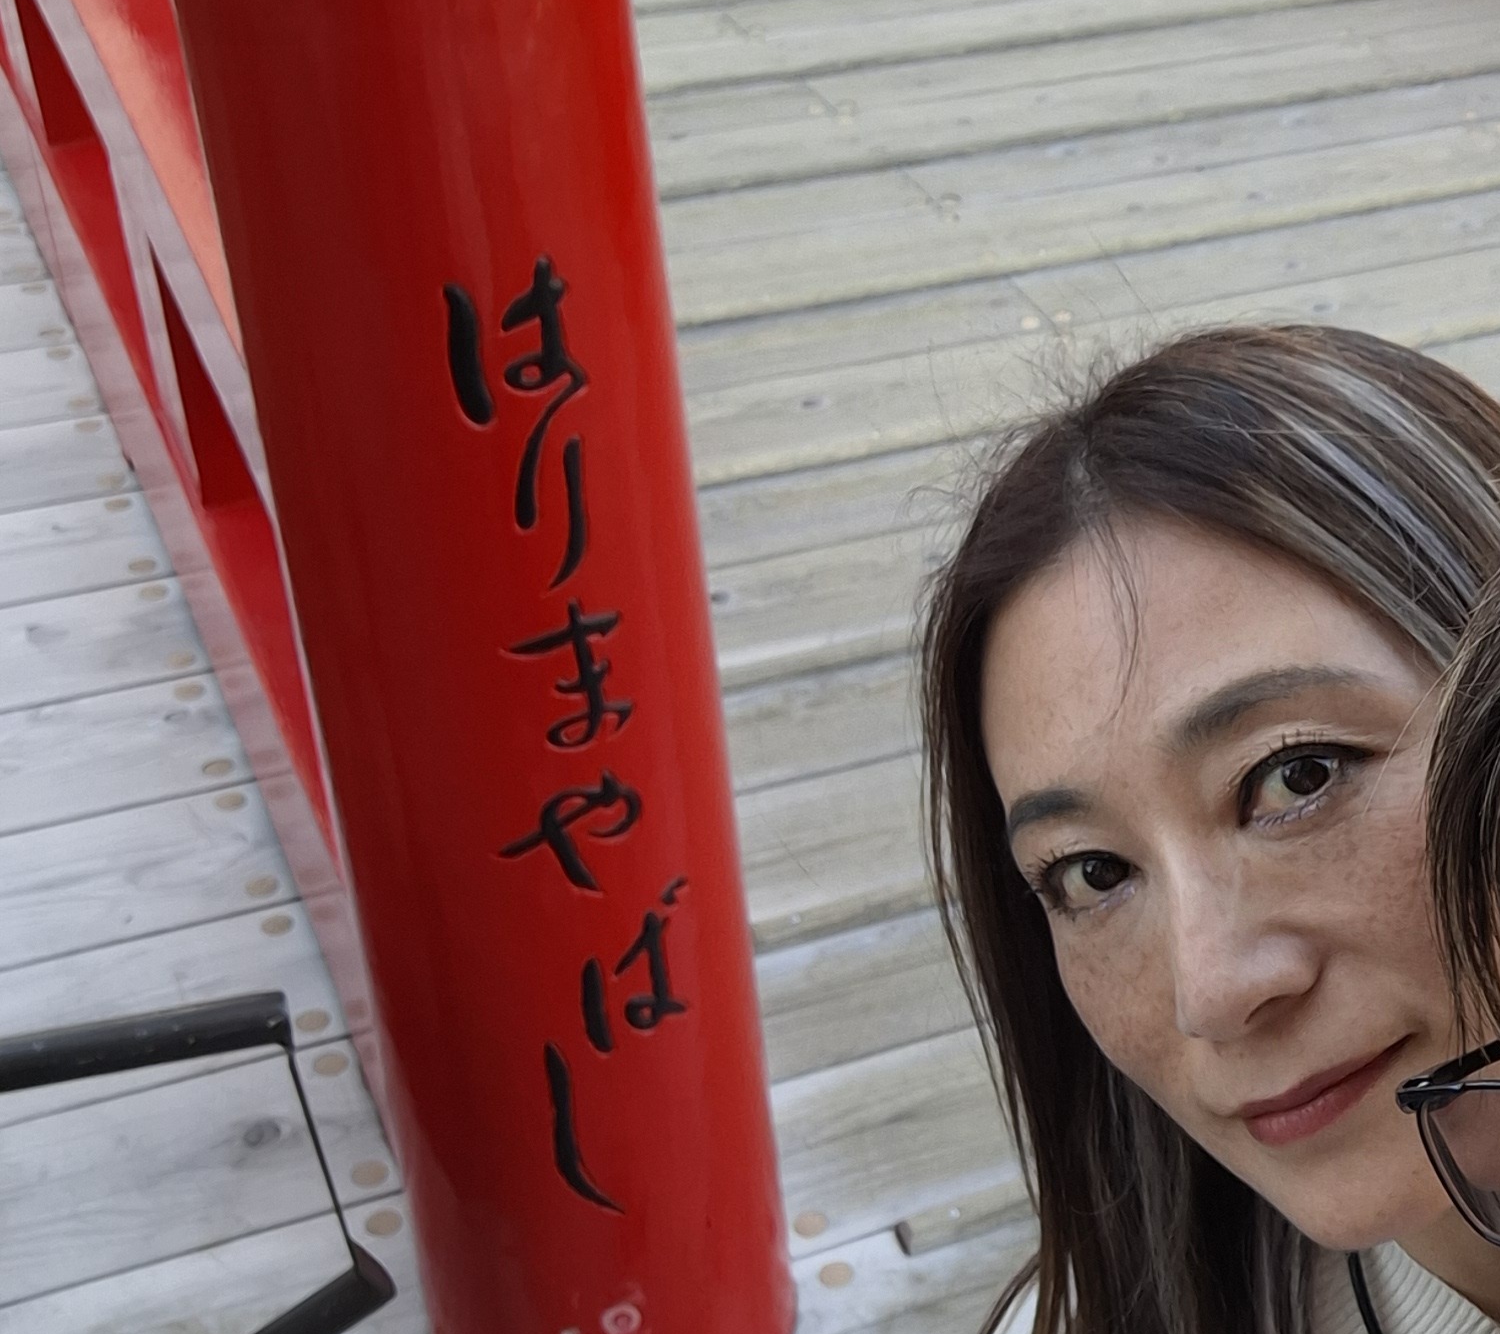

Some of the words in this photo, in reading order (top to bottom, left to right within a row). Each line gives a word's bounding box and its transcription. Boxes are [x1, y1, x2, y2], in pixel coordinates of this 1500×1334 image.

[443, 255, 690, 1215] はりまやばし
